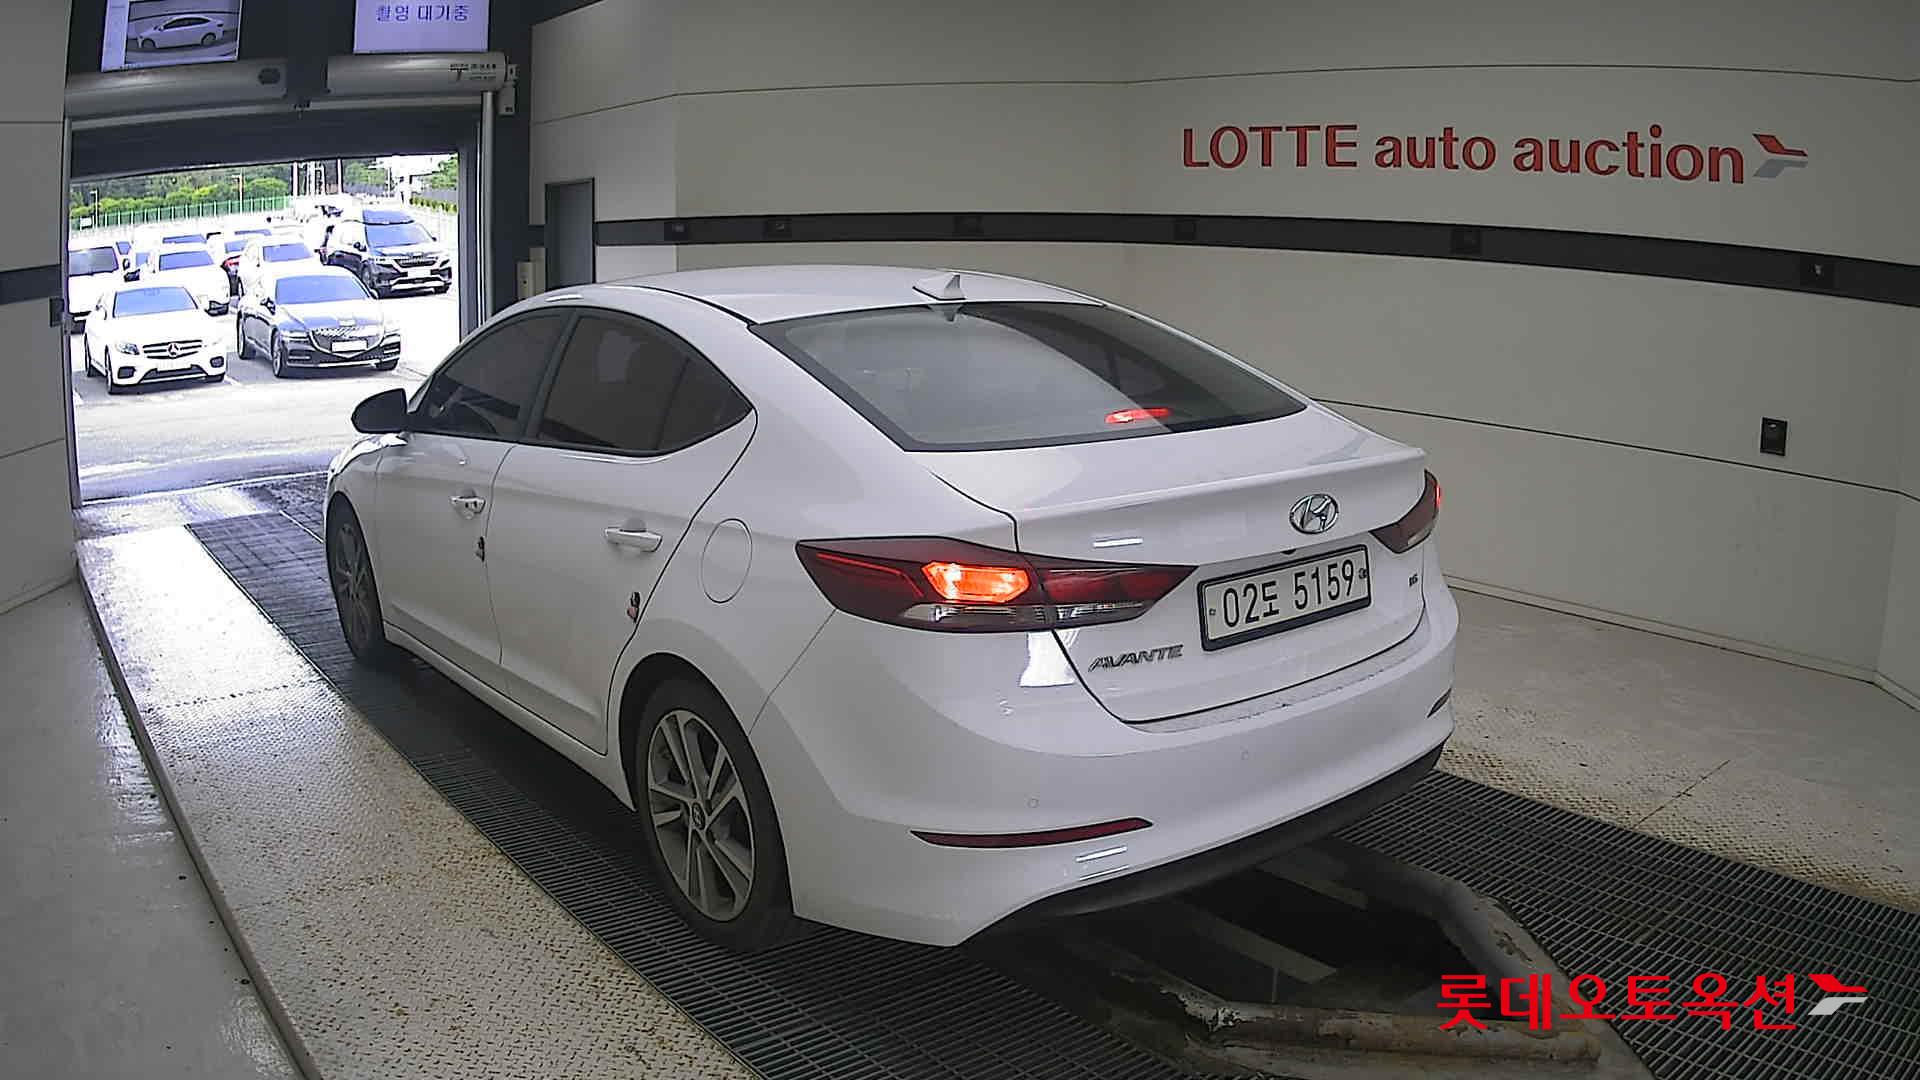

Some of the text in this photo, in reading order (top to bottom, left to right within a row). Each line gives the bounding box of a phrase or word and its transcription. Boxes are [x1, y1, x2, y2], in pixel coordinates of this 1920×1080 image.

[417, 4, 470, 22] 대기중
[1183, 124, 1744, 184] LOTTE auto auction
[1223, 559, 1354, 628] 02도 5159
[1088, 644, 1184, 672] AVANTE
